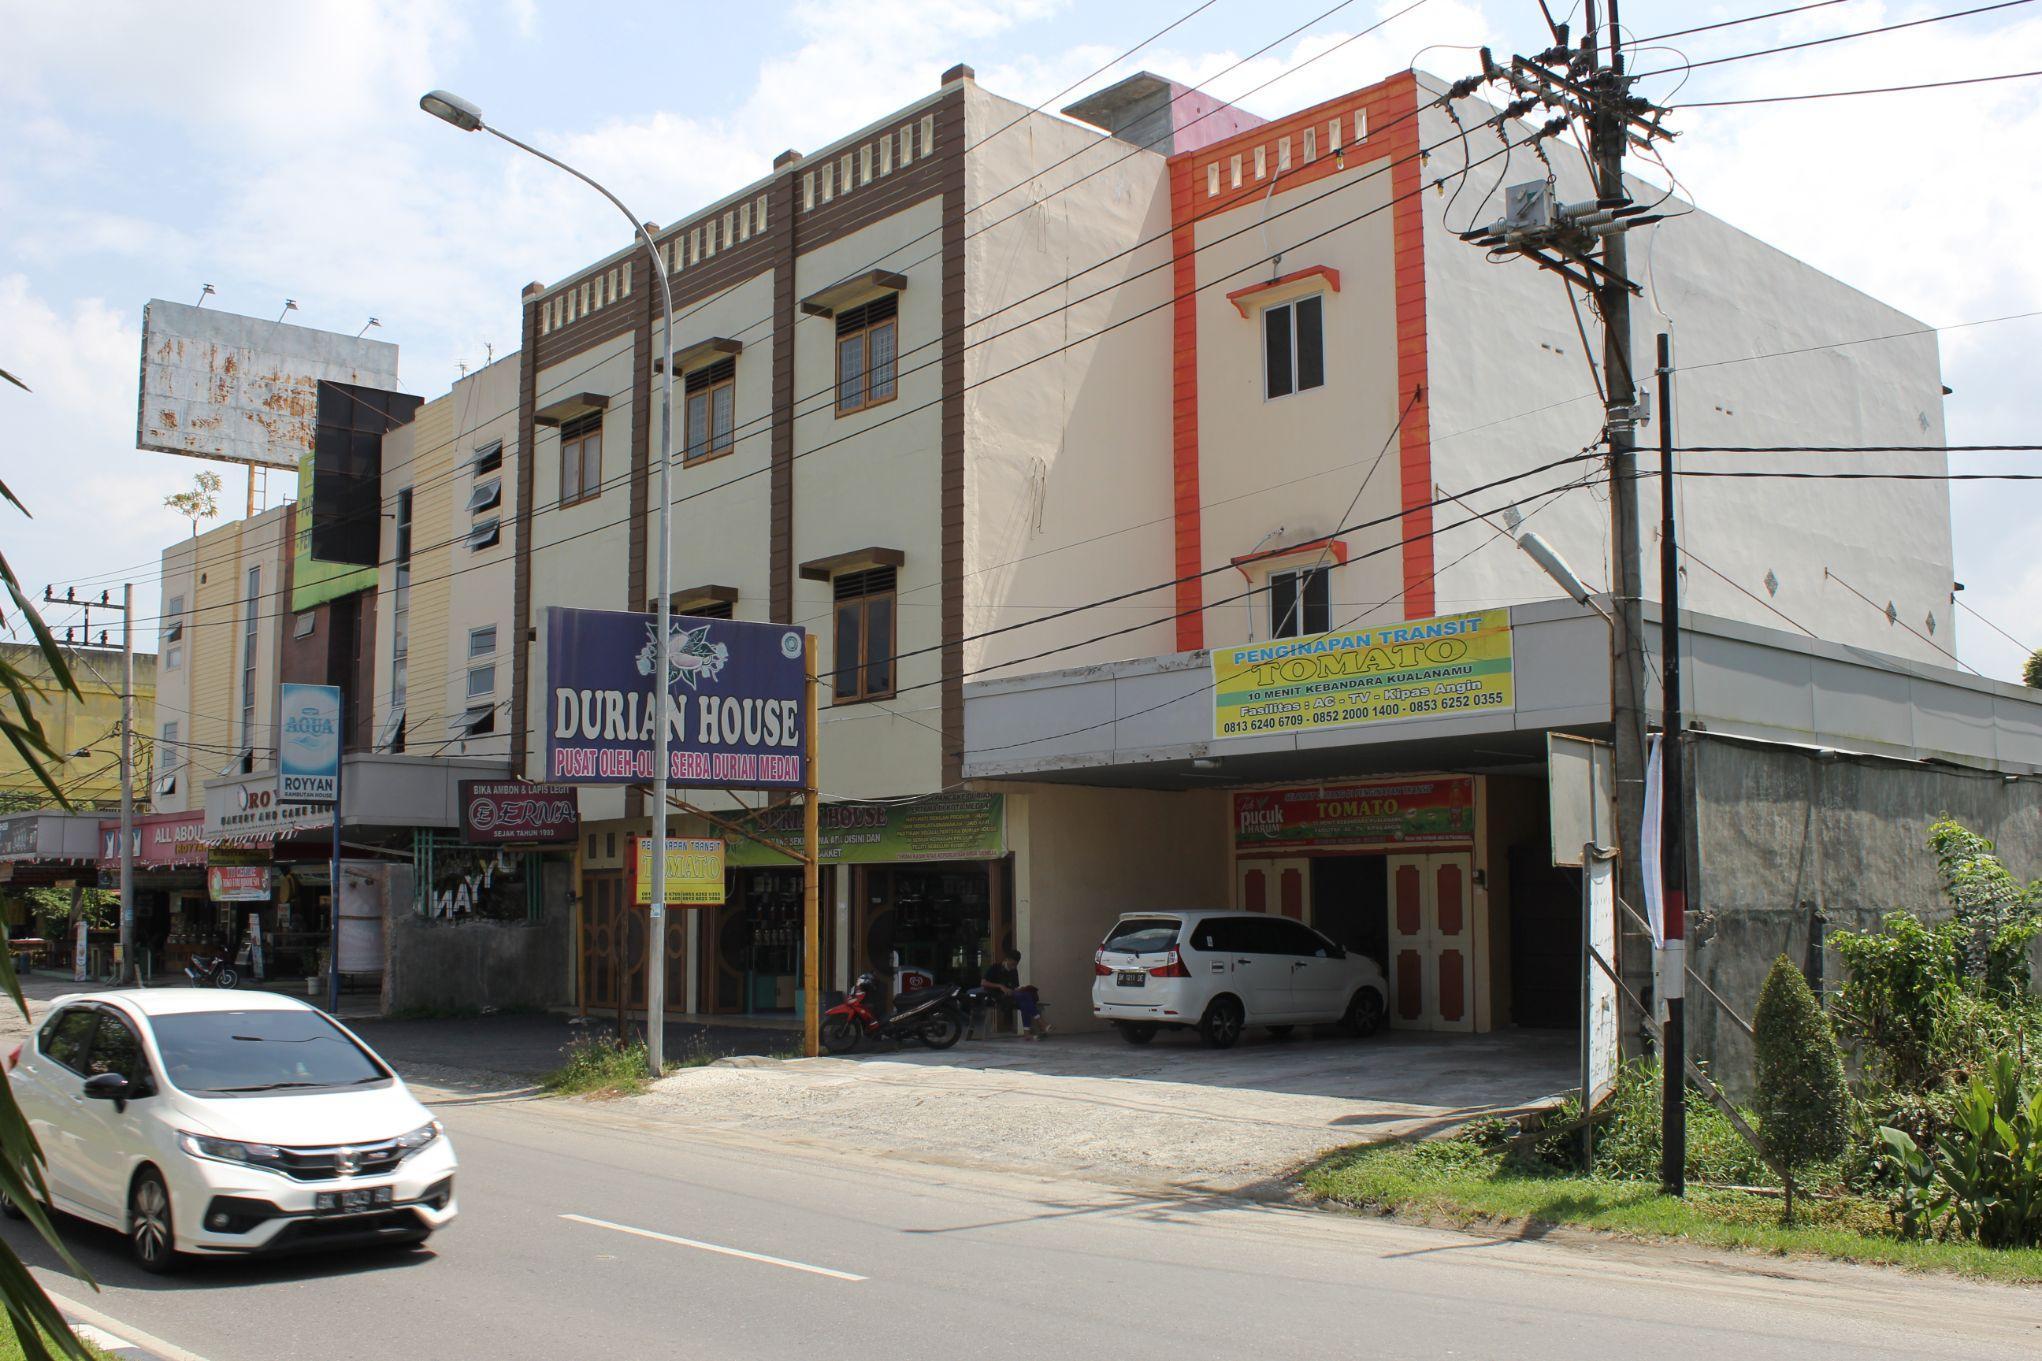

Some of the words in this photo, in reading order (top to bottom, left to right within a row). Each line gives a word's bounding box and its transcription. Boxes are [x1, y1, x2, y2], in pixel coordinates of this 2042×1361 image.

[1234, 633, 1371, 665] PENGINAPAN
[1378, 617, 1482, 645] TRANSIT
[1251, 637, 1468, 687] TOMATO
[1248, 692, 1261, 702] 10
[1264, 687, 1301, 699] MENIT
[1305, 677, 1383, 694] KEBANDARA
[1387, 665, 1473, 684] KUALANAMU
[1224, 719, 1248, 733] 0813
[1251, 717, 1275, 731] 6240
[1279, 714, 1303, 727] 6709
[1313, 710, 1339, 724] 0852
[1343, 706, 1369, 720] 2000
[1372, 703, 1399, 717] 1400
[1409, 699, 1438, 713] 0853
[1441, 696, 1470, 709] 6252
[1473, 692, 1503, 706] 0355
[1240, 701, 1300, 718] Fasilitas
[1313, 696, 1336, 709] AC
[1348, 691, 1371, 705] TV
[1384, 686, 1430, 701] Kipas
[1434, 680, 1482, 694] Angin
[285, 715, 334, 737] AQUA
[554, 687, 688, 743] DURIAN
[698, 695, 799, 748] HOUSE
[555, 747, 598, 777] PUSAT
[671, 751, 711, 780] SERBA
[713, 753, 758, 781] DURIAN
[759, 754, 800, 782] MEDAN
[285, 777, 333, 791] ROYYAN
[473, 785, 492, 795] BIKA
[493, 785, 520, 795] AMBON
[528, 785, 549, 794] LAPIS
[549, 785, 569, 794] LEGIT
[258, 810, 278, 822] AND
[282, 806, 307, 819] CAKE
[496, 799, 577, 827] ERNA
[826, 805, 888, 830] HOUSE
[1240, 804, 1284, 834] pucuk
[1315, 799, 1399, 819] TOMATO
[154, 827, 172, 844] ALL
[174, 824, 206, 842] ABOU
[866, 833, 880, 844] DAN
